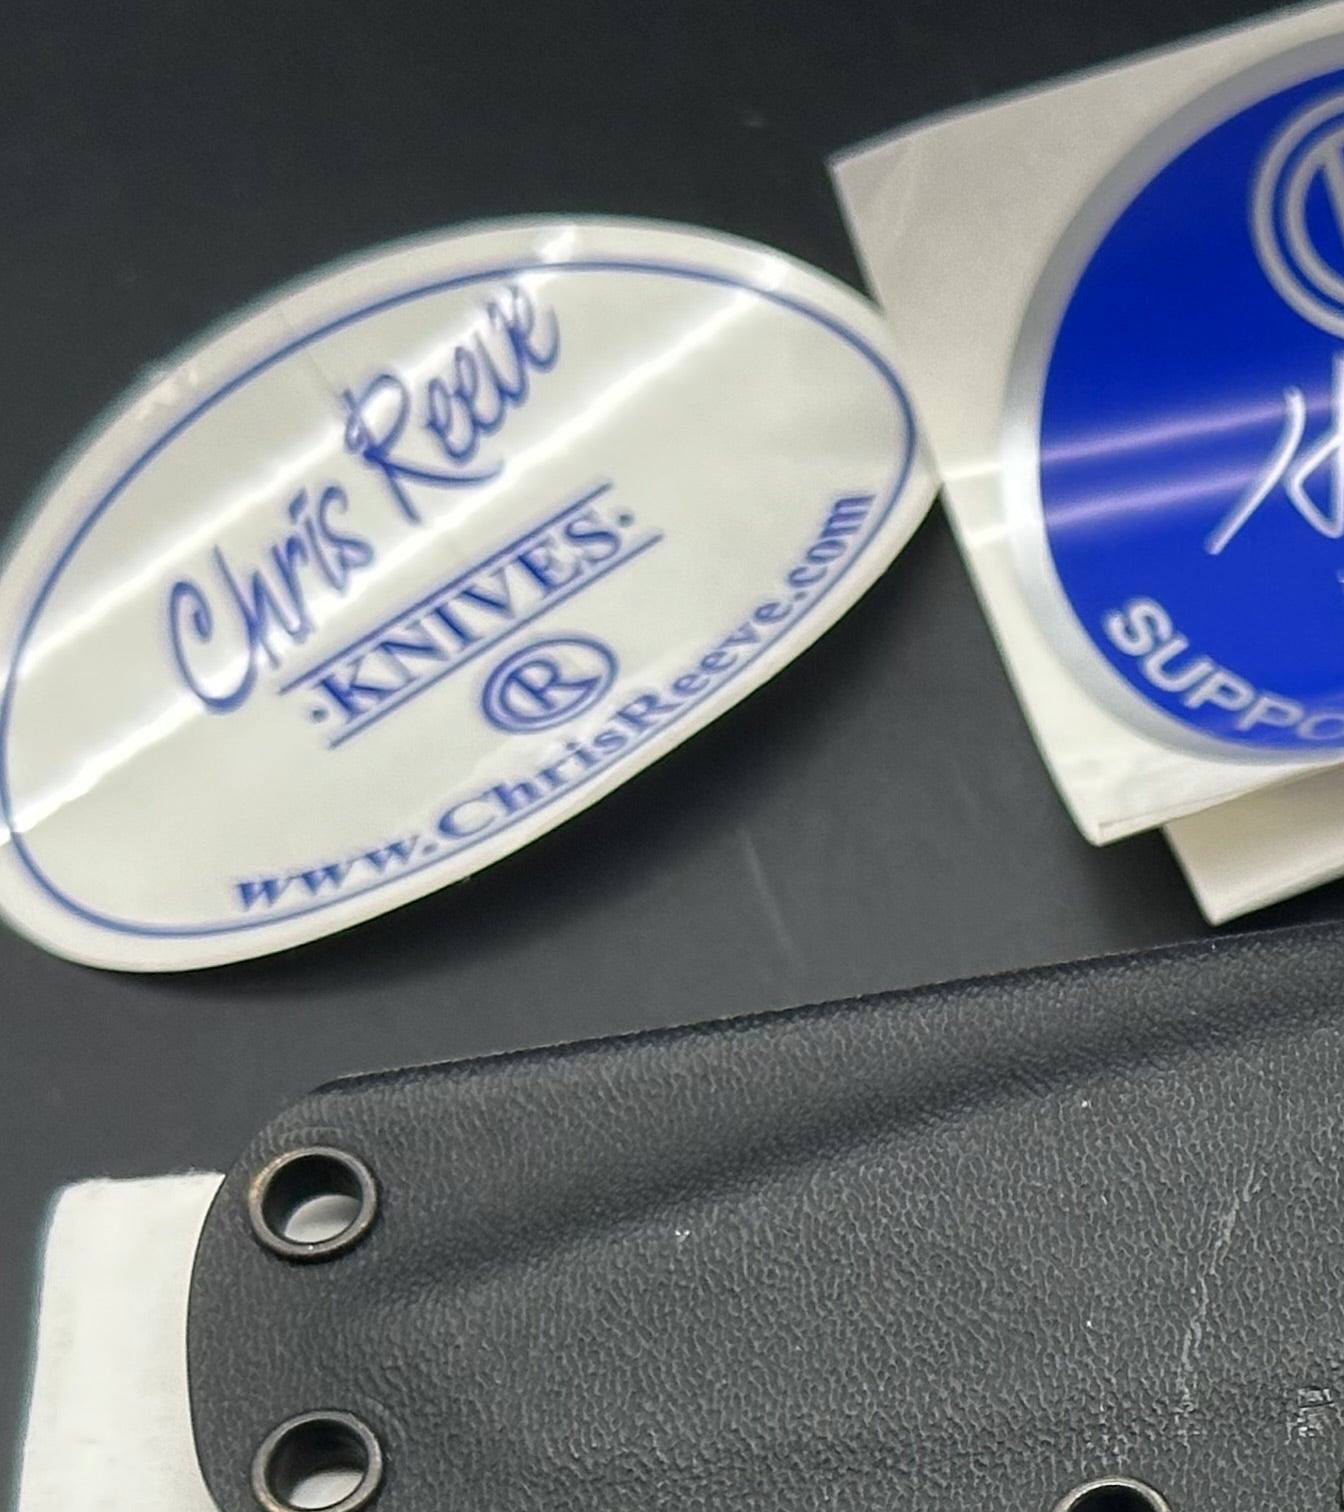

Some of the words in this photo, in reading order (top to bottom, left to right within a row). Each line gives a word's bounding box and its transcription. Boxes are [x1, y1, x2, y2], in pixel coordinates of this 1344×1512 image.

[166, 484, 374, 713] Chris
[343, 285, 562, 526] Reeve
[234, 493, 876, 912] www.ChrisReeve.com
[319, 506, 625, 726] KNIVES
